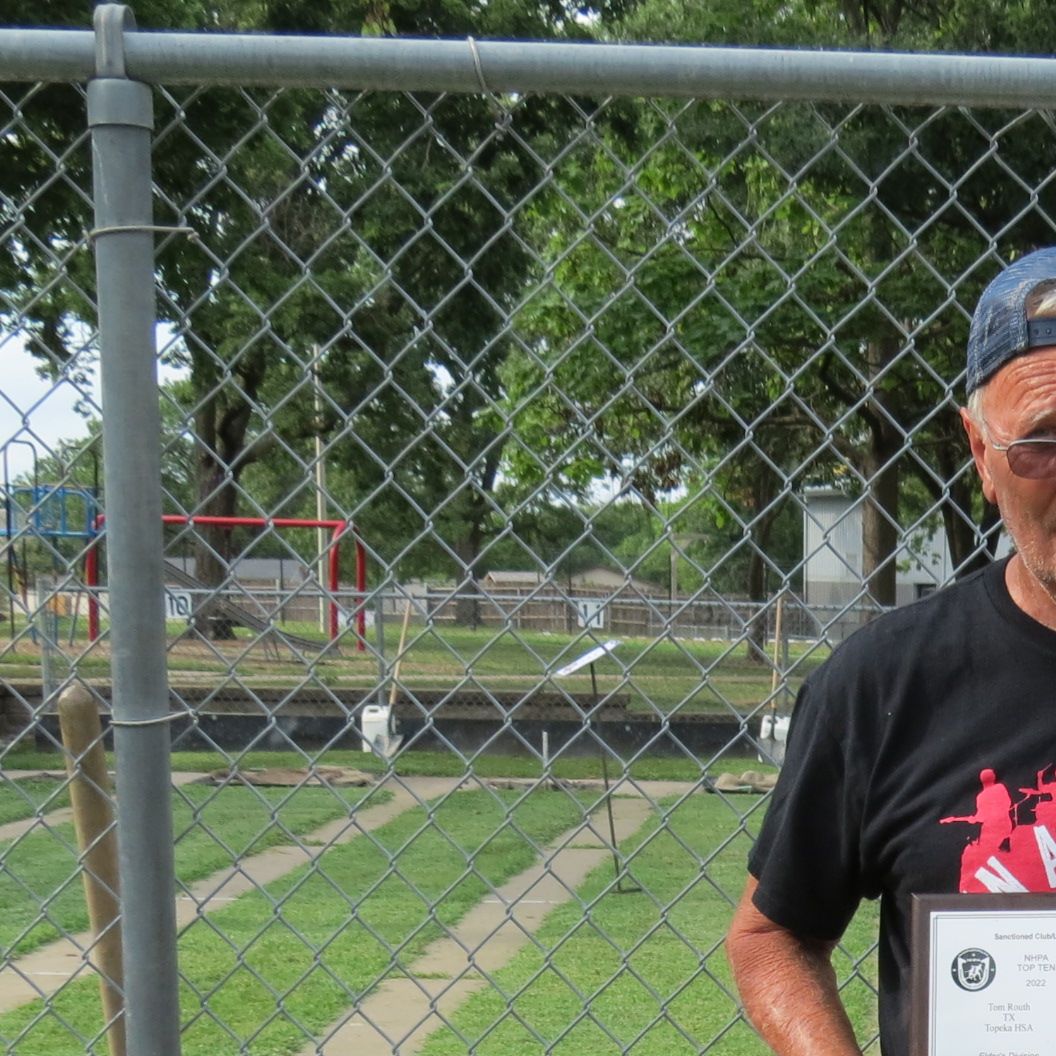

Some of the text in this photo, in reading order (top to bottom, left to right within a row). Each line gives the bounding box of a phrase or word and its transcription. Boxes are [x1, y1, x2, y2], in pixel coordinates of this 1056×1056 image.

[168, 596, 188, 616] 10
[994, 932, 1032, 940] Sanctioned
[1024, 954, 1048, 962] NHPA
[1018, 964, 1056, 972] TOP TEN
[1026, 979, 1046, 987] 2022
[988, 1002, 1031, 1011] Tom Routh
[1002, 1013, 1016, 1022] TX
[984, 1024, 1034, 1033] Topeka HSA
